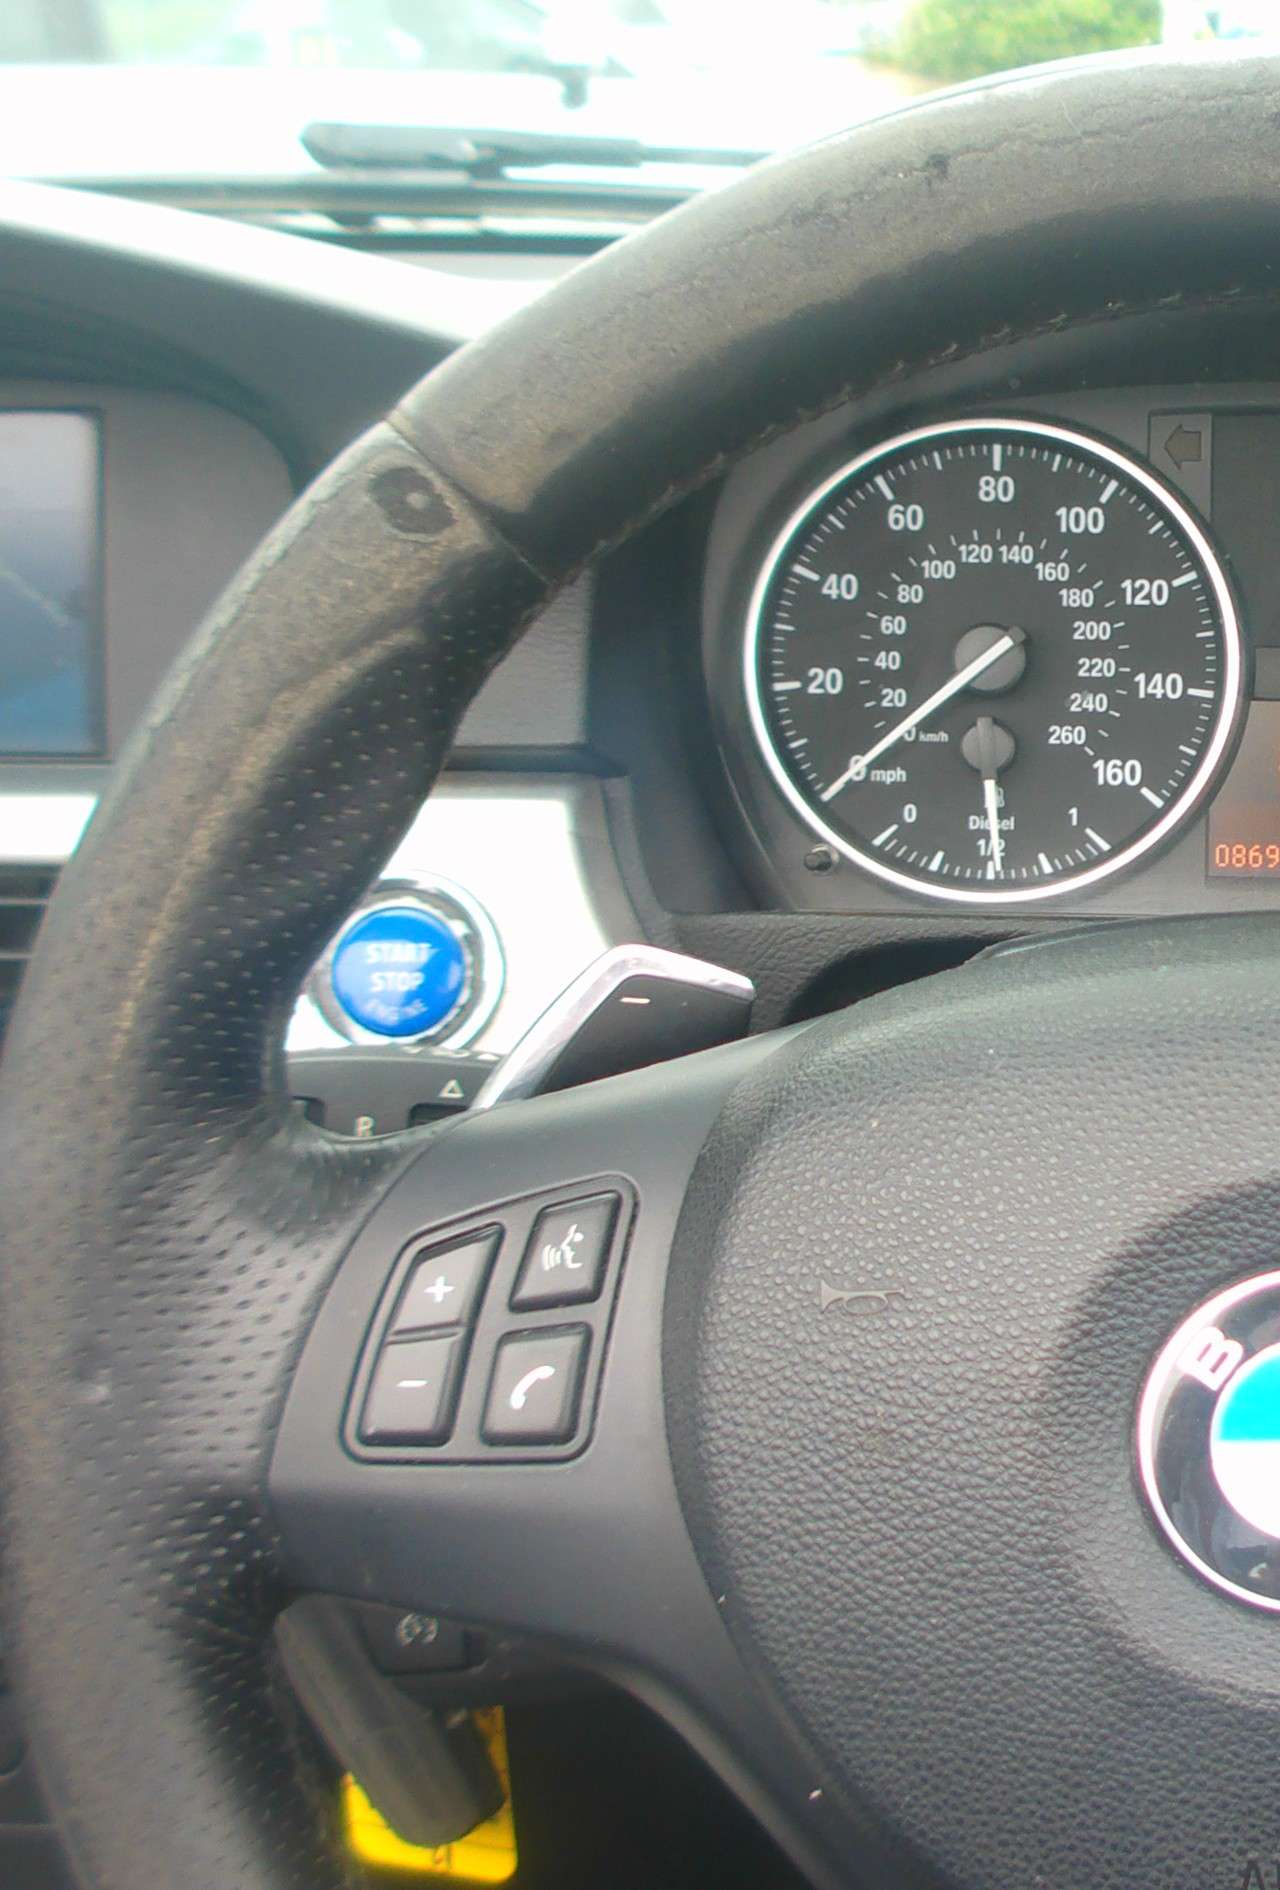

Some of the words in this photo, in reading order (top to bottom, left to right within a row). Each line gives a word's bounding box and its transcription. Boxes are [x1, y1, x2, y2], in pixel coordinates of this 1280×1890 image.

[978, 476, 1014, 503] 80
[888, 504, 924, 531] 60
[1055, 506, 1105, 534] 100
[958, 544, 993, 564] 120
[998, 544, 1034, 564] 140
[921, 559, 956, 580] 100
[1035, 562, 1070, 582] 160
[821, 573, 858, 600] 40
[897, 584, 924, 604] 80
[1121, 578, 1169, 606] 120
[1059, 588, 1094, 608] 180
[880, 615, 907, 635] 60
[1073, 621, 1111, 641] 200
[874, 651, 901, 670] 40
[1077, 657, 1116, 678] 220
[807, 667, 843, 695] 20
[1134, 672, 1183, 700] 140
[881, 688, 907, 708] 20
[1069, 692, 1108, 713] 240
[919, 731, 948, 742] km/h
[1048, 725, 1086, 745] 260
[870, 767, 907, 784] mph
[1093, 759, 1142, 786] 160
[903, 803, 917, 823] 0
[968, 815, 1015, 831] Dieel
[1068, 807, 1078, 826] 1
[976, 838, 1006, 857] 1/2
[366, 942, 433, 963] START
[370, 971, 424, 992] STOP
